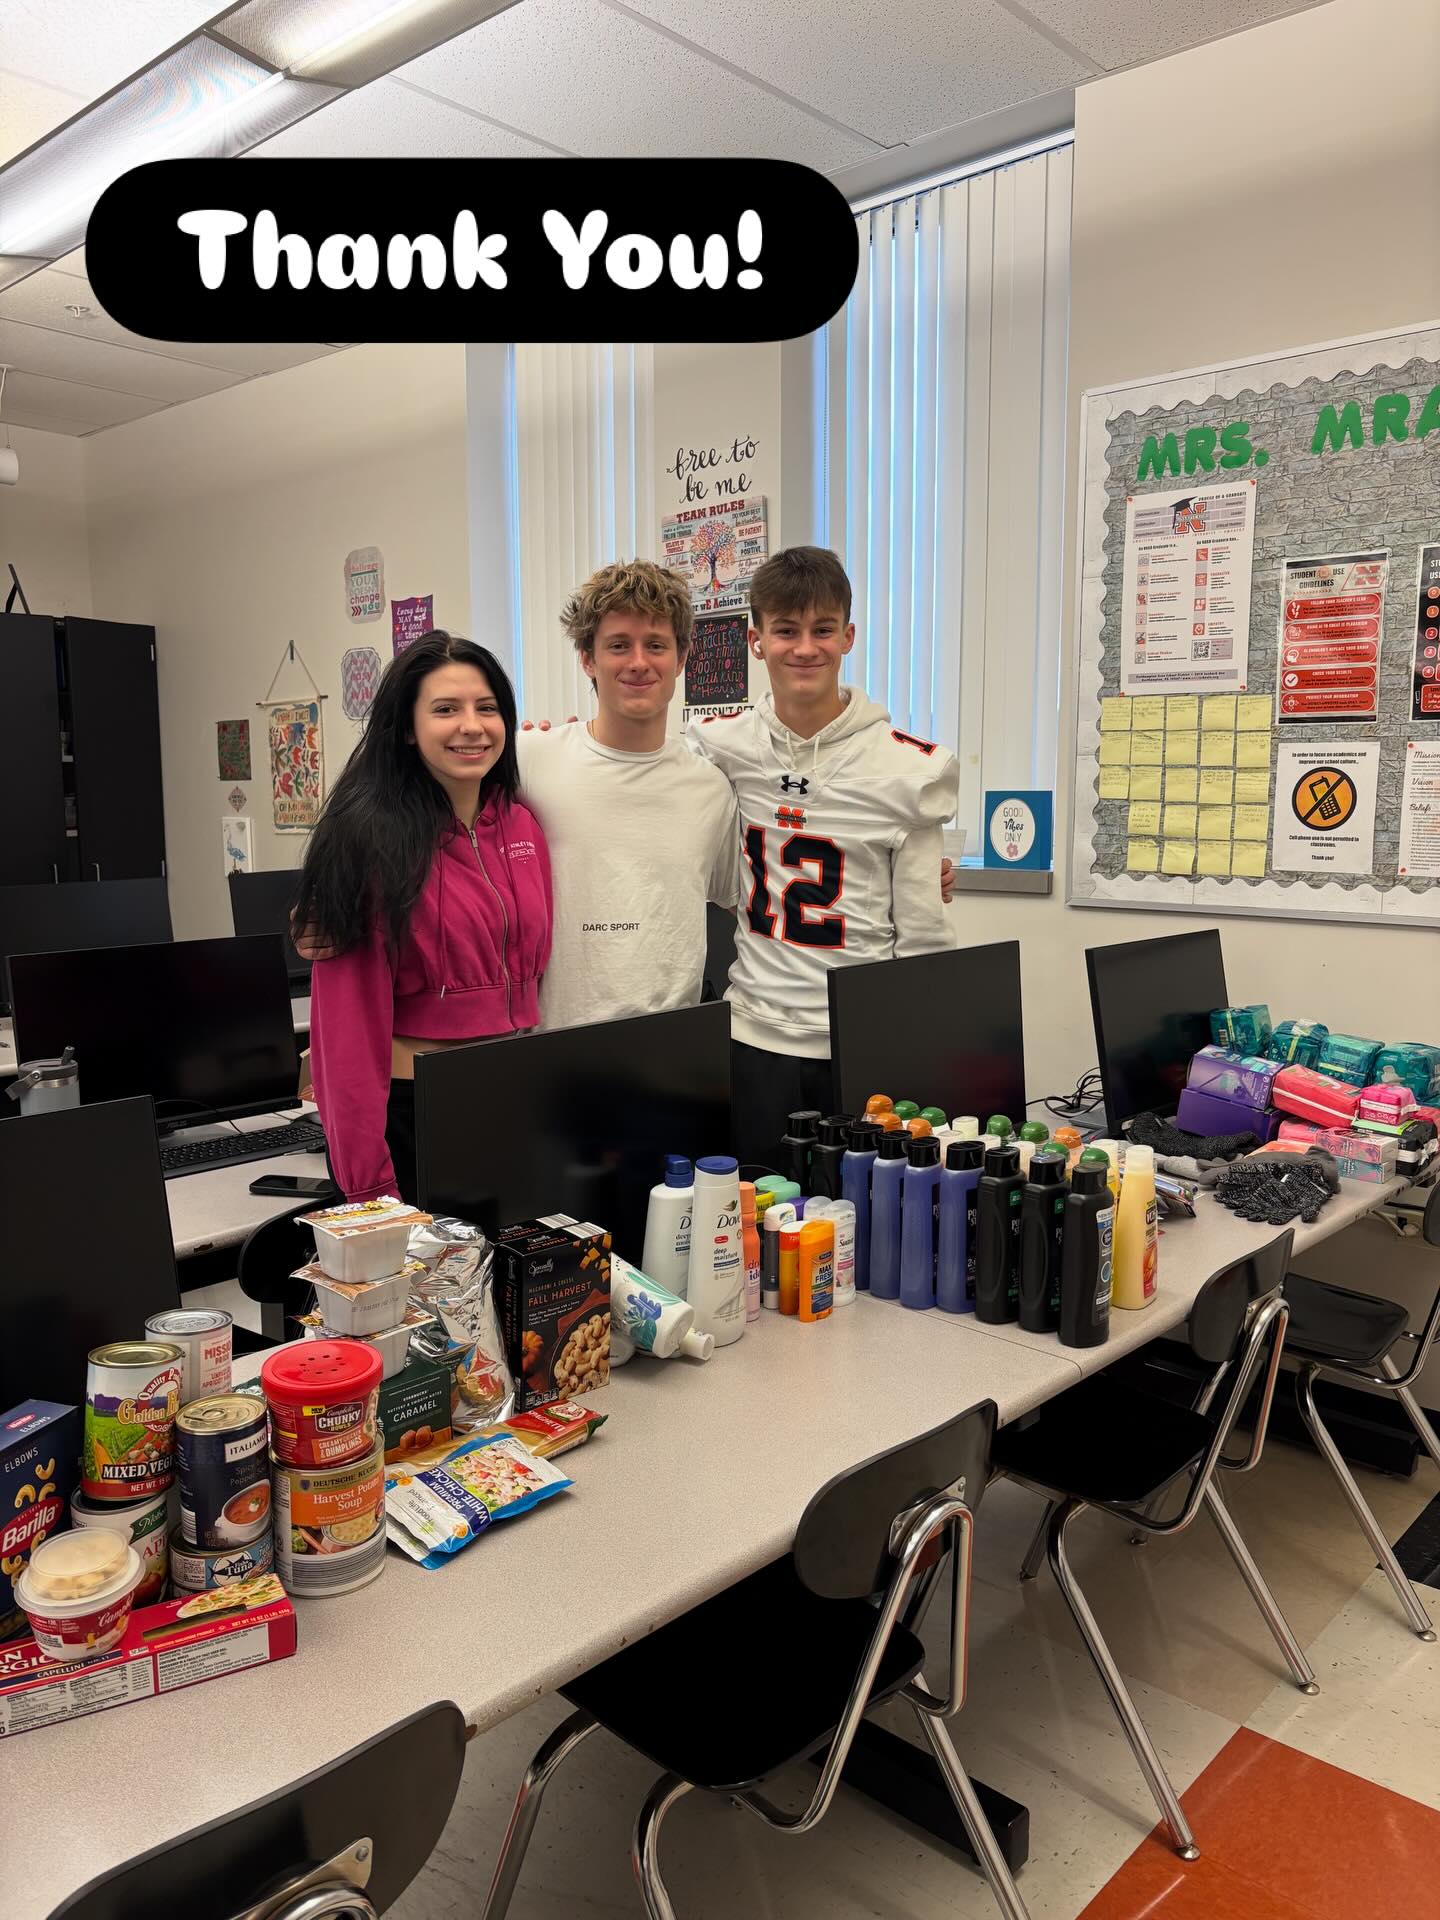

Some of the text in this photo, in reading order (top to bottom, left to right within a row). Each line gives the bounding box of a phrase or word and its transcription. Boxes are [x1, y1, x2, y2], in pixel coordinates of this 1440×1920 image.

[666, 434, 760, 480] free to
[1136, 421, 1269, 481] MRS.
[679, 473, 752, 503] be me
[676, 500, 745, 523] TEAM RULES
[1290, 570, 1316, 579] STUDENT
[1299, 579, 1334, 589] GUIDELINES
[350, 593, 380, 604] change
[713, 596, 742, 608] Achieve
[362, 602, 380, 615] you
[1003, 807, 1024, 817] GOOD
[1409, 804, 1431, 814] Beliefs
[1003, 818, 1024, 832] Vibes
[1005, 832, 1022, 842] ONLY
[741, 824, 846, 949] 12
[582, 922, 640, 931] DARC SPORT
[714, 1247, 727, 1256] deep
[818, 1264, 832, 1274] MAX
[529, 1281, 592, 1307] FALL HARVEST
[118, 1398, 165, 1424] Golden
[394, 1400, 437, 1422] CARAMEL
[318, 1409, 360, 1429] CHUNKY
[4, 1447, 39, 1473] ELBOWS
[103, 1465, 146, 1478] MIXED
[131, 1484, 144, 1492] NET
[429, 1481, 463, 1510] PREMIUM
[313, 1489, 354, 1504] Harvest
[338, 1496, 362, 1511] Soup
[462, 1496, 488, 1524] WHITE
[2, 1506, 56, 1552] Barilla
[225, 1562, 254, 1575] Tuna
[37, 1662, 85, 1679] CAPELLINI
